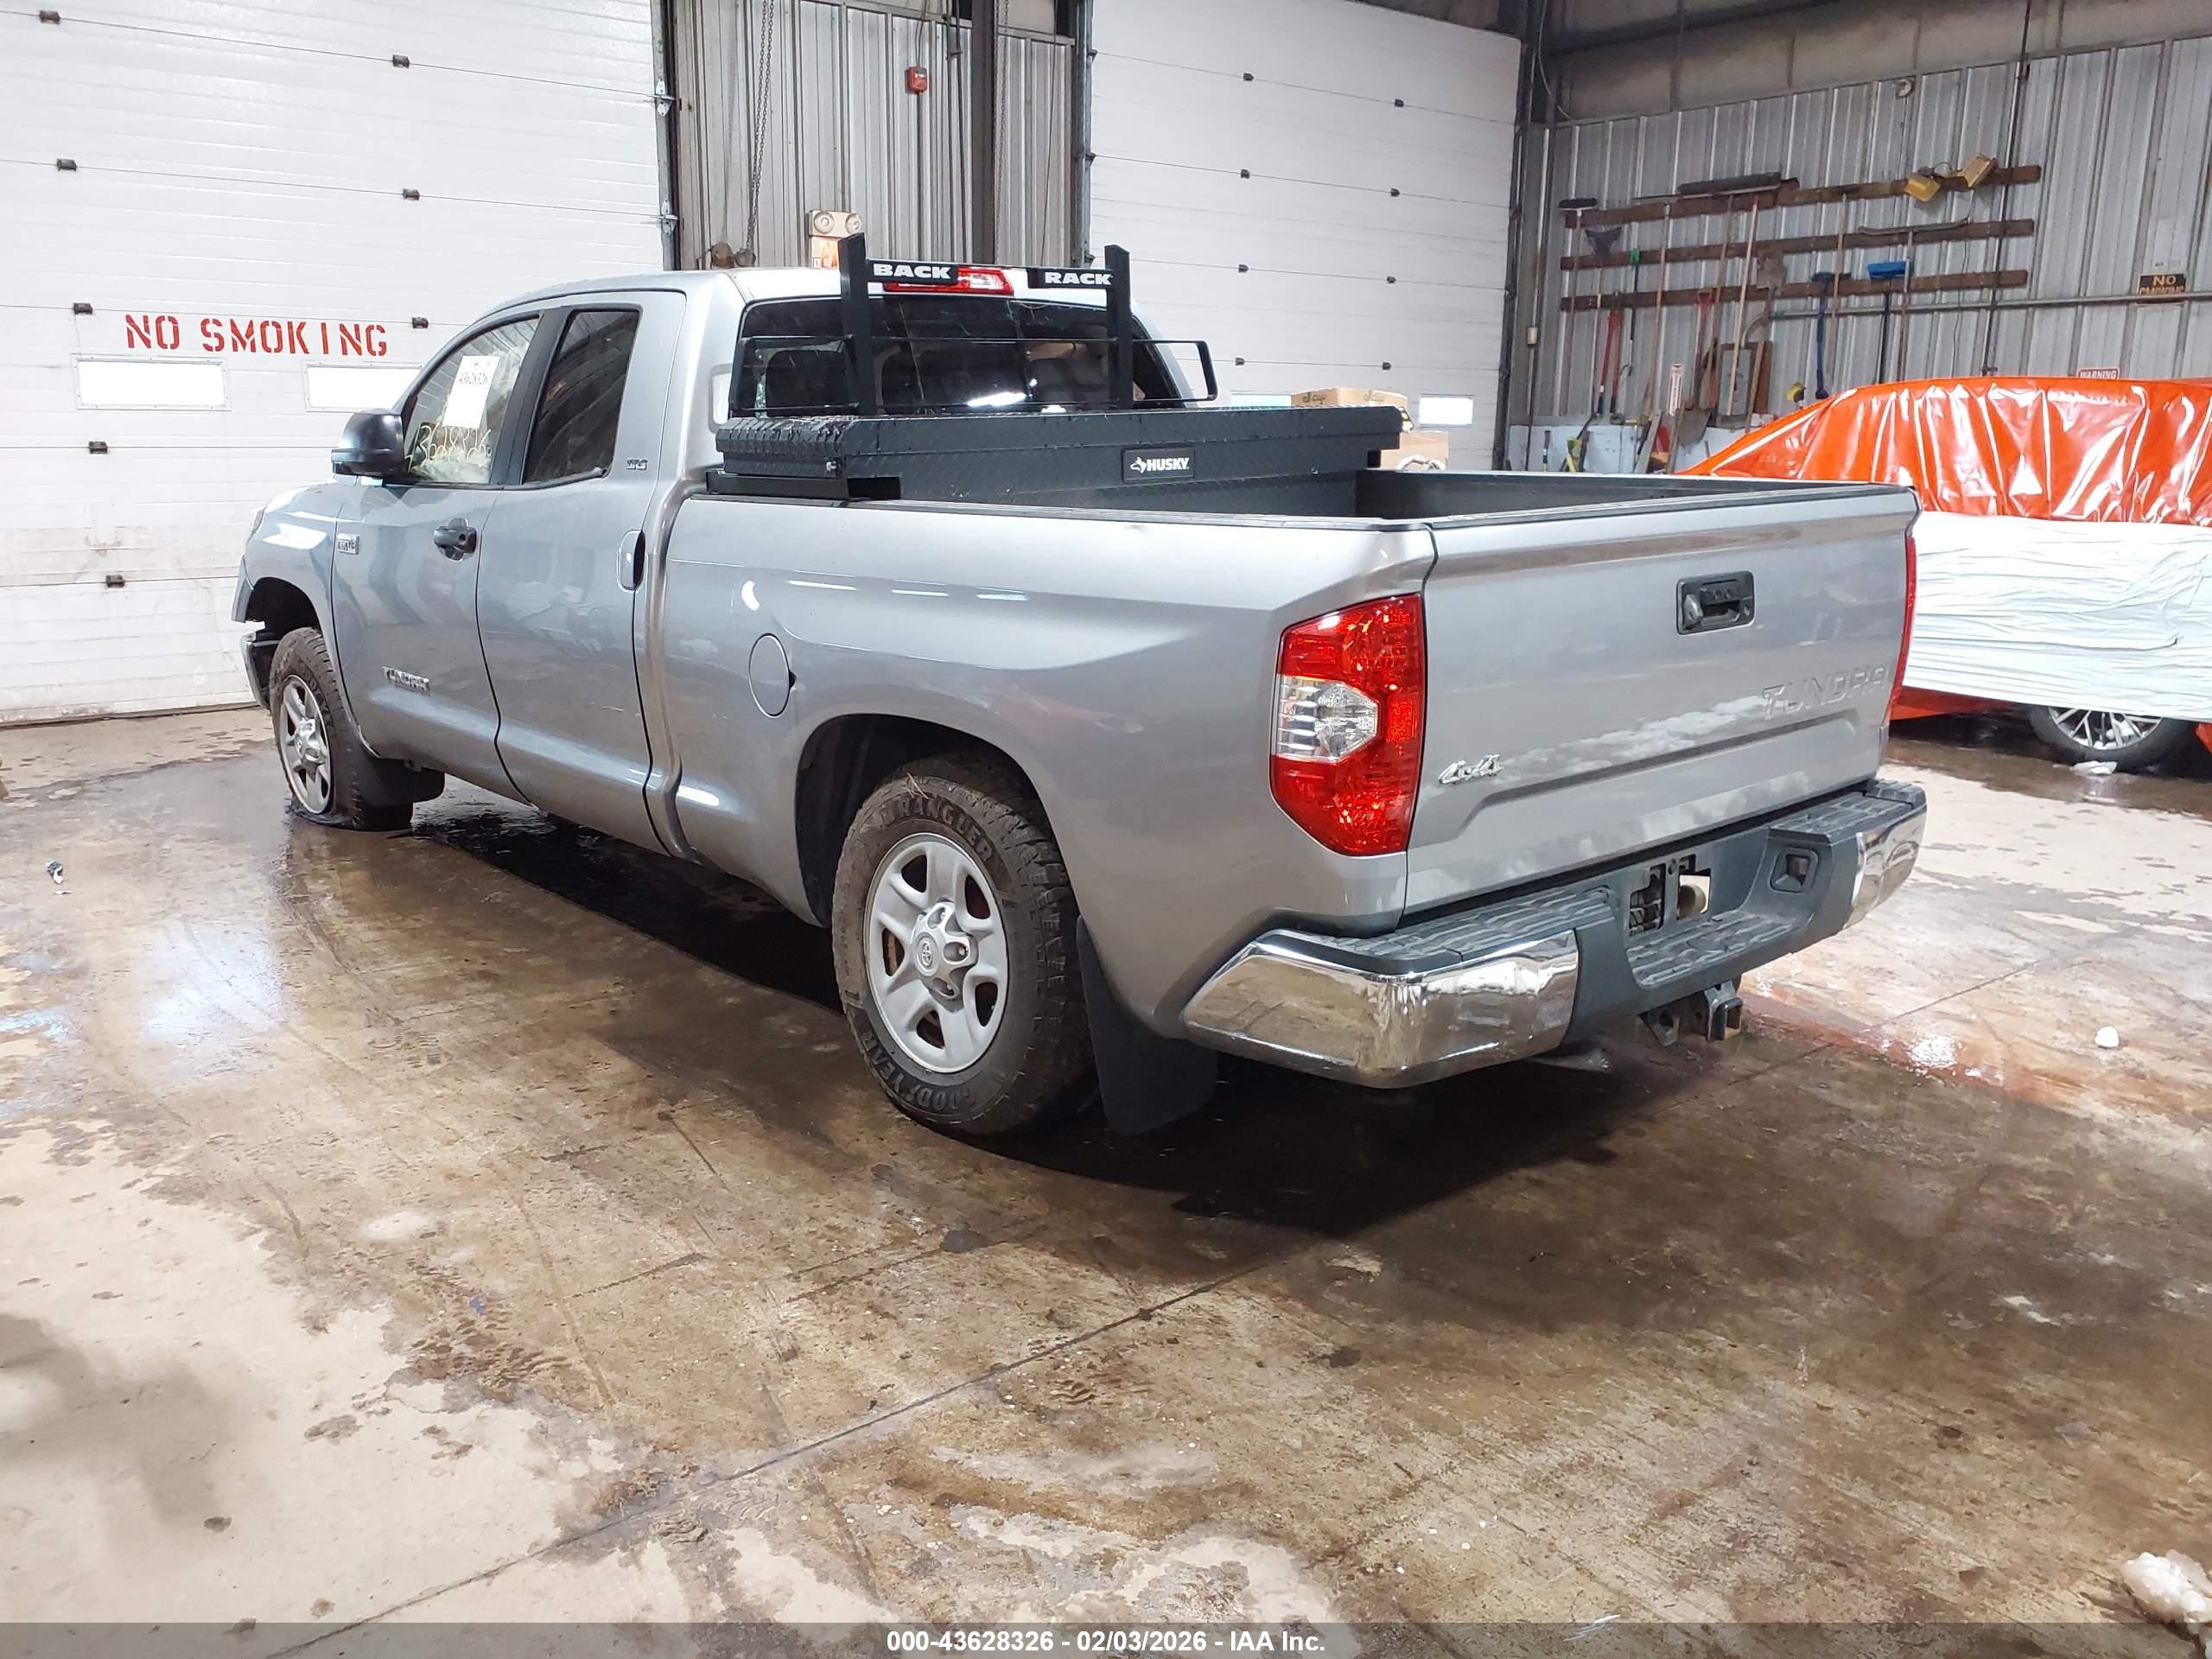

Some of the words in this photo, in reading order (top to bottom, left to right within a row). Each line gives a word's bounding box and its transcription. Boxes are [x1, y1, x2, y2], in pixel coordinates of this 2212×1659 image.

[873, 263, 951, 279] BACK
[1044, 271, 1113, 286] RACK
[2152, 275, 2177, 286] NO
[124, 315, 181, 350] NO
[200, 317, 388, 357] SMOKING
[1147, 457, 1190, 472] HUSKY
[1763, 666, 1891, 721] TUNDRA
[1438, 753, 1501, 784] 4x4
[879, 793, 994, 861] WRANGLER
